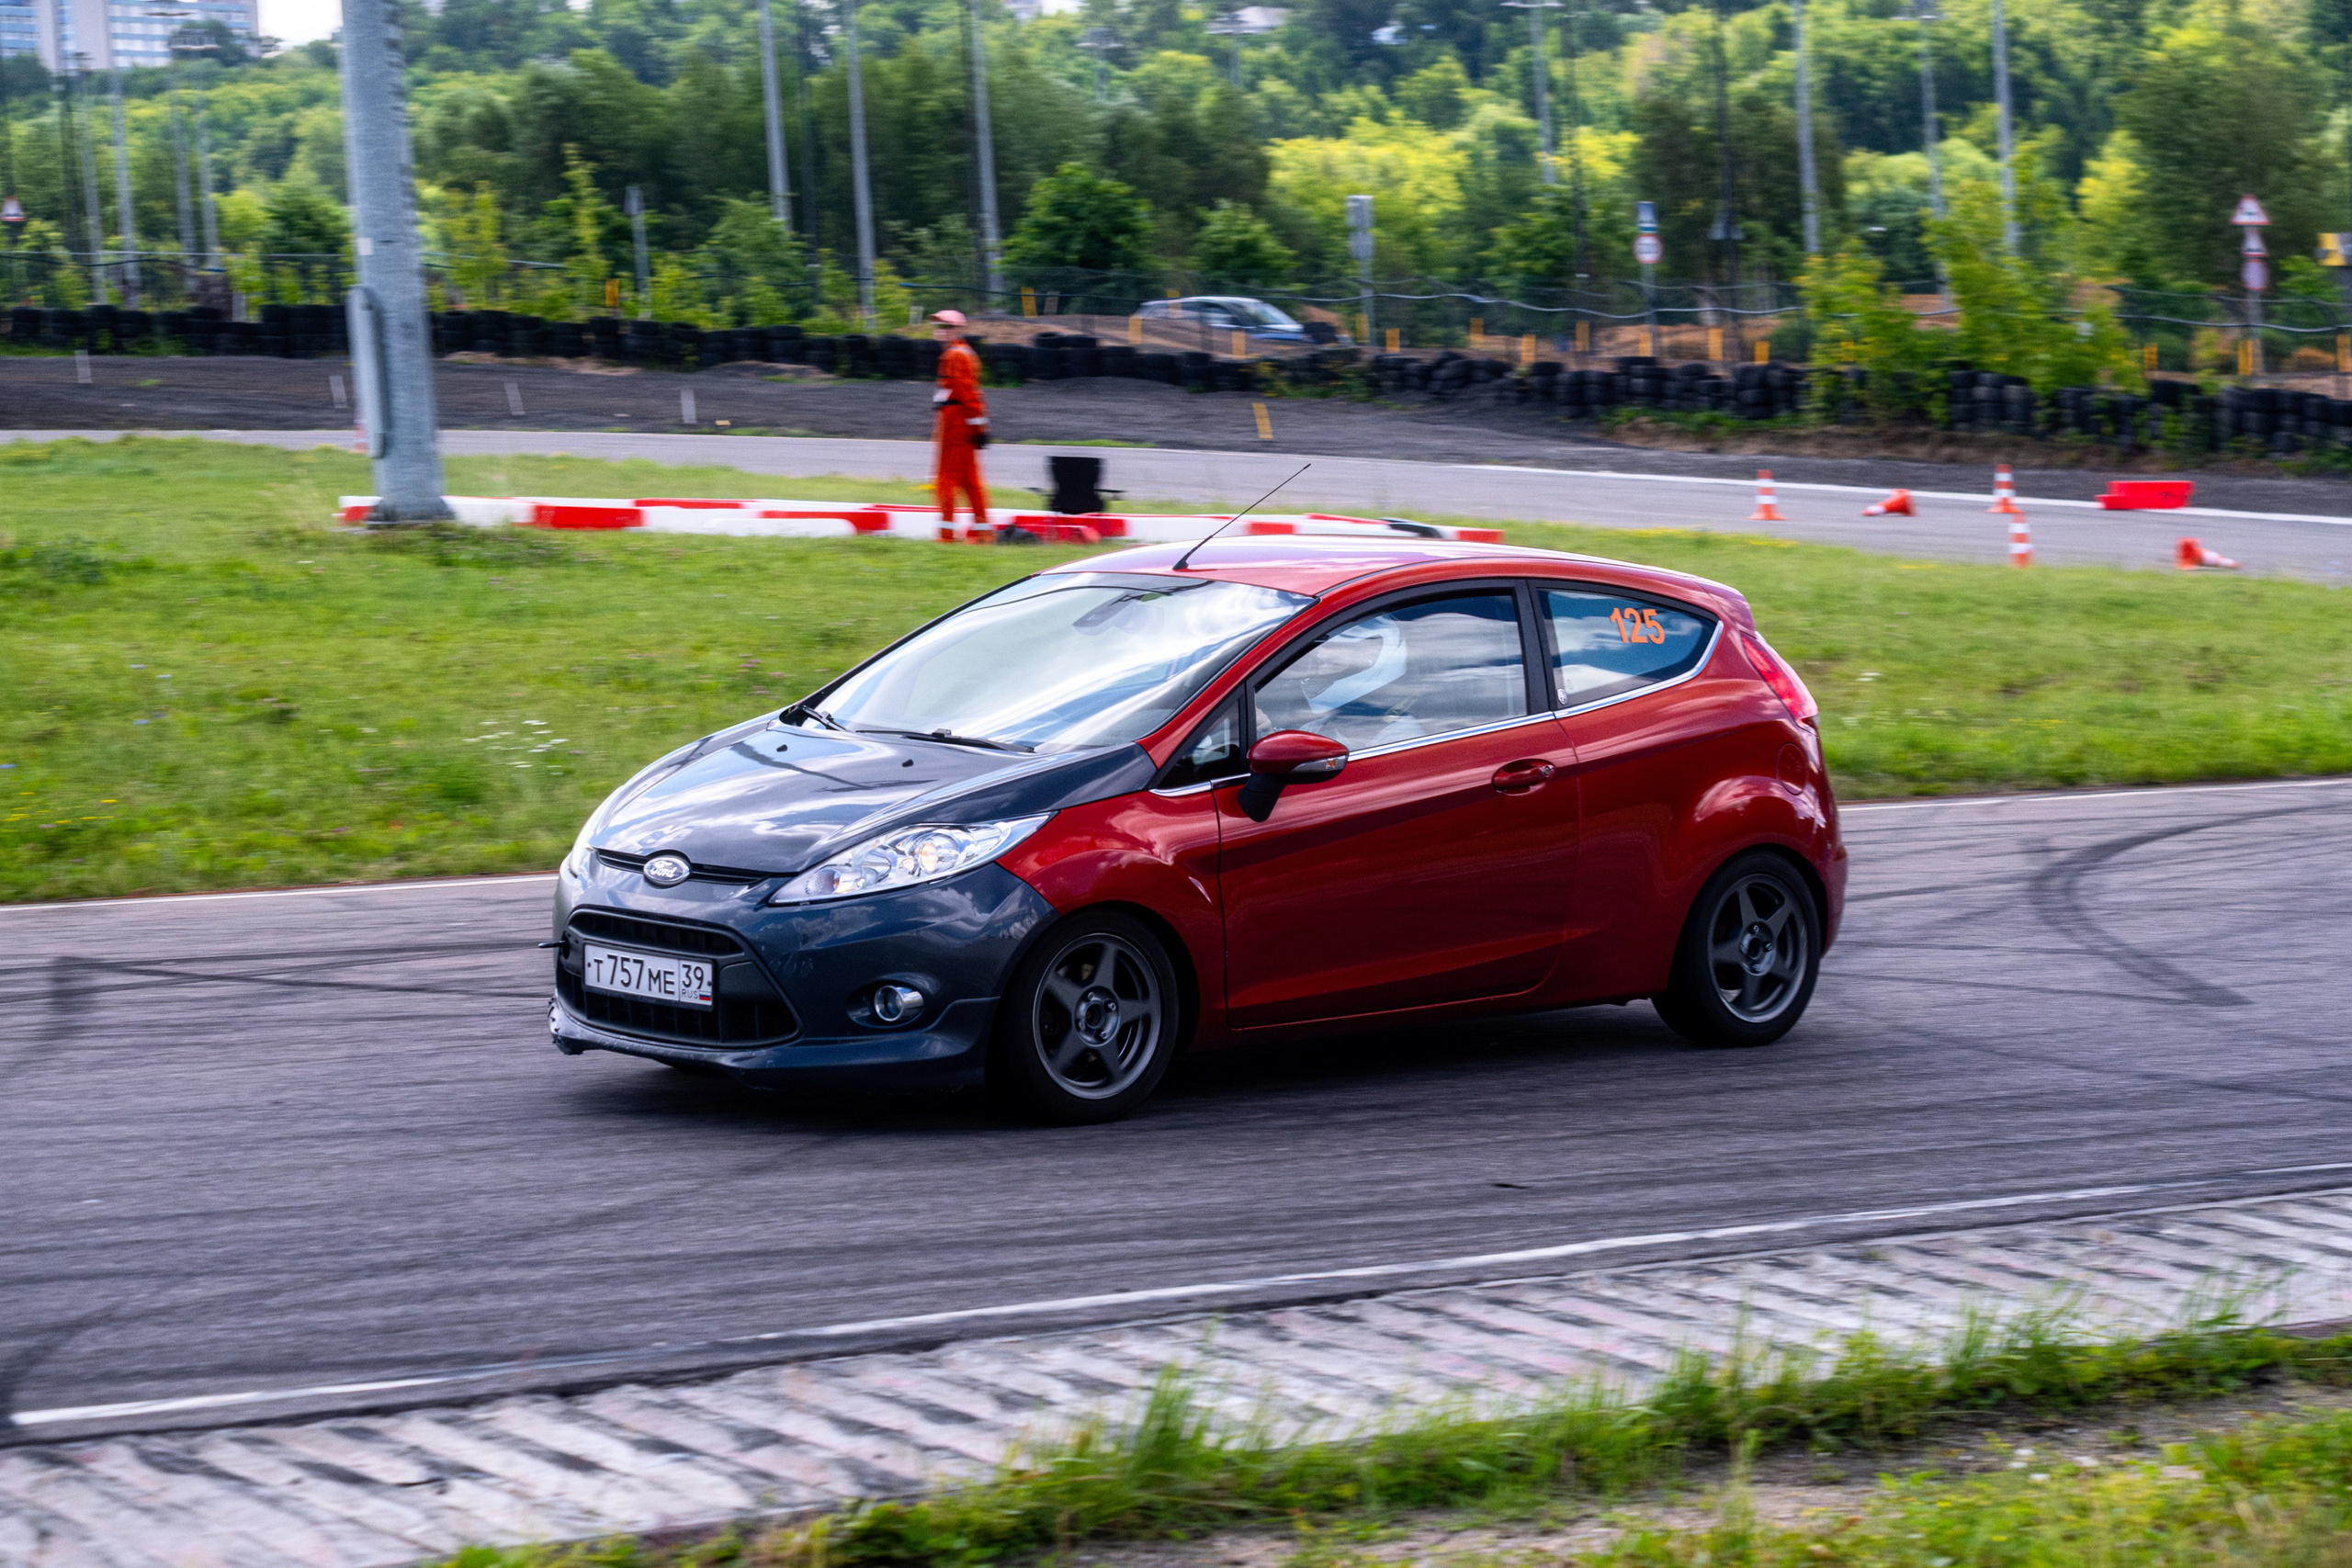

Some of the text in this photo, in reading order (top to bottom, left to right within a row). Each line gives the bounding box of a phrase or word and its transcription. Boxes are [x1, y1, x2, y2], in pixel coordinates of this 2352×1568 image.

[1610, 607, 1665, 644] 125
[650, 860, 678, 878] Ford
[682, 964, 704, 990] 39
[682, 988, 698, 999] RUS
